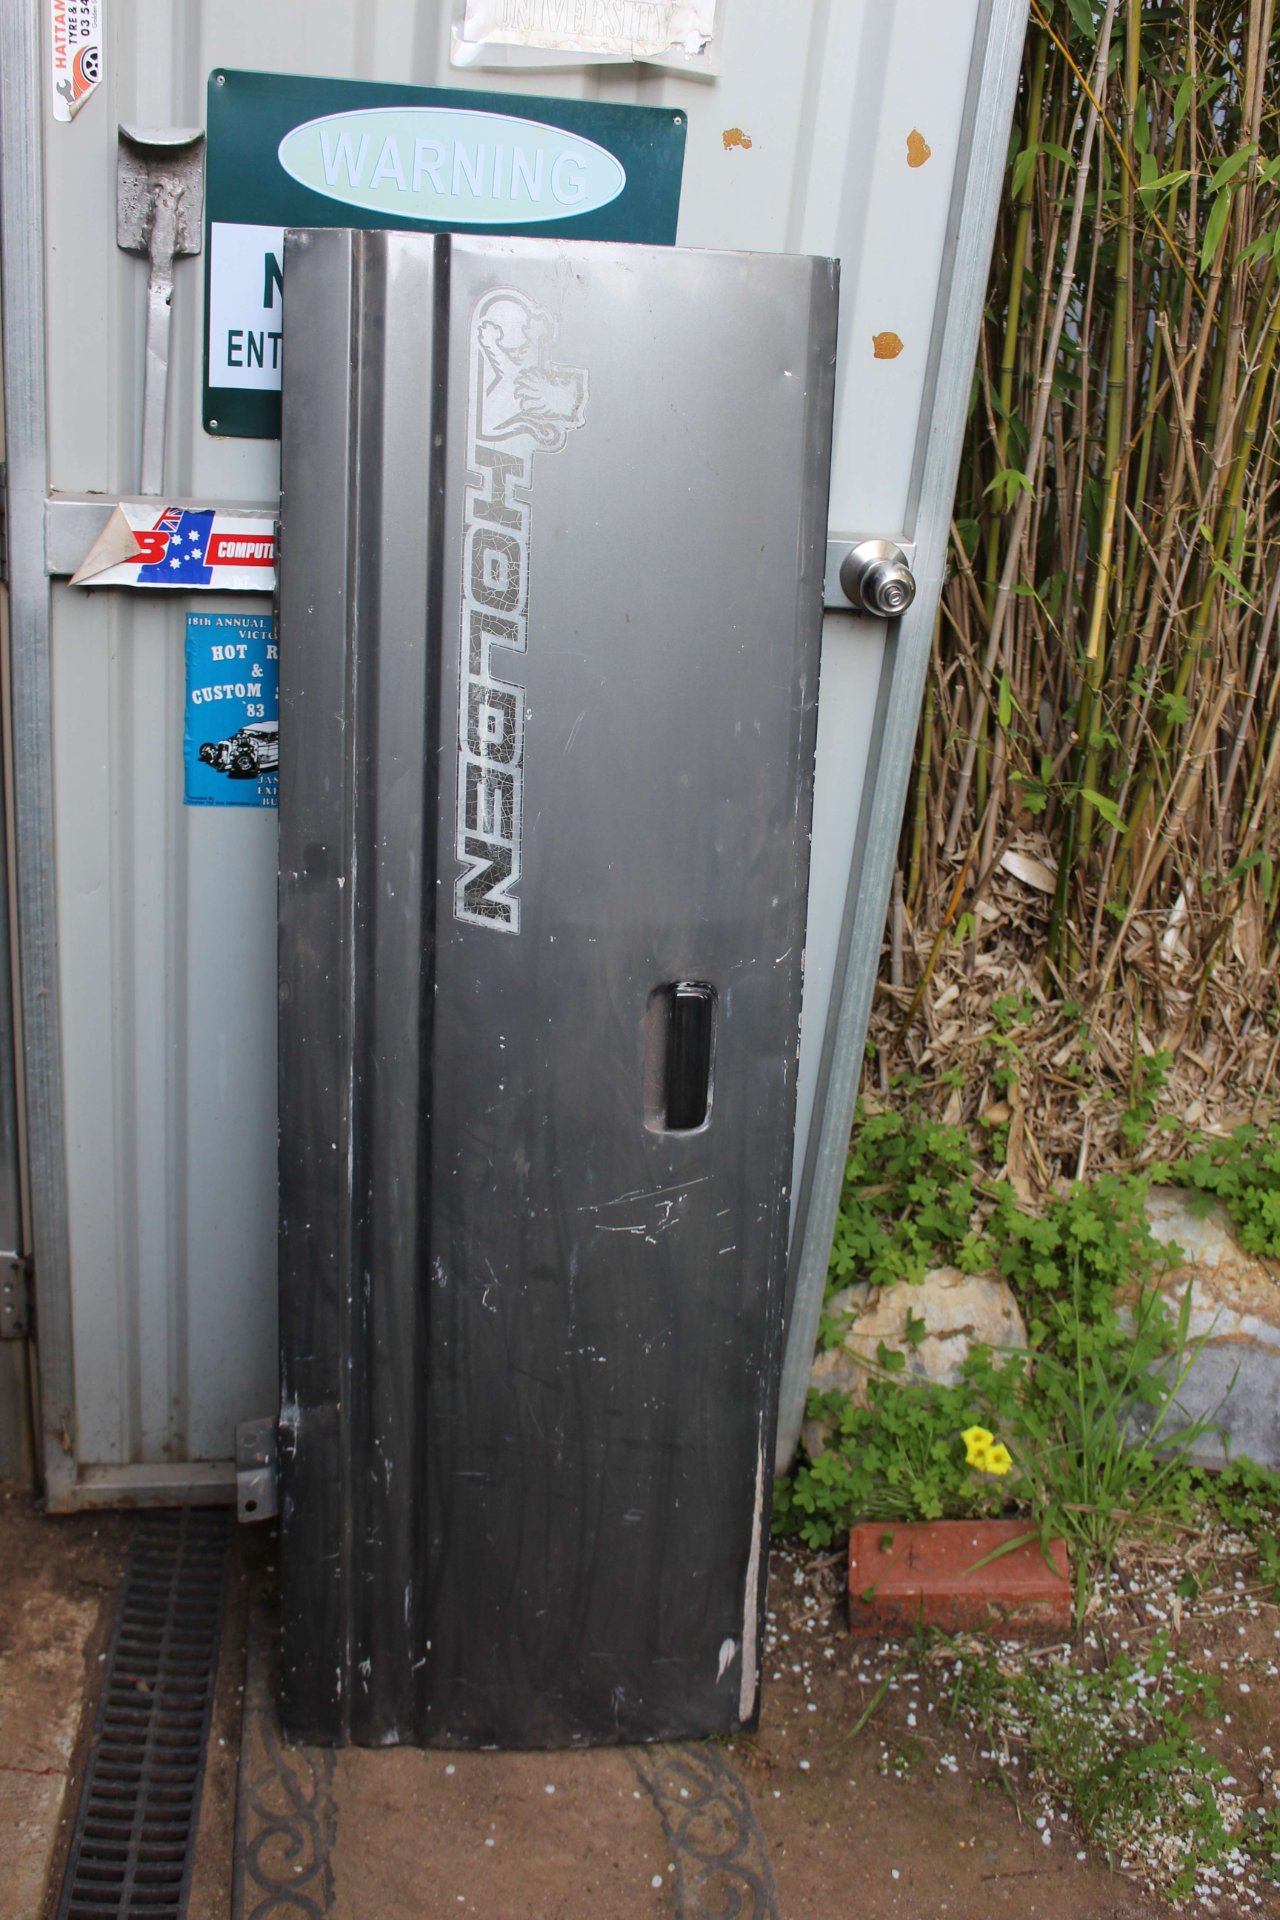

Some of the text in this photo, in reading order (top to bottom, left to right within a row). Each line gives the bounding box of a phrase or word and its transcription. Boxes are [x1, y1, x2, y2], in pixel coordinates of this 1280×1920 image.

[68, 6, 77, 14] &
[69, 17, 77, 45] TYRE
[80, 19, 90, 37] 03
[318, 129, 590, 206] WARNING
[188, 617, 266, 628] 18th ANNUAL
[211, 644, 248, 661] HOT
[251, 663, 264, 678] &
[191, 683, 262, 705] CUSTOM
[458, 444, 531, 926] HOLDEN
